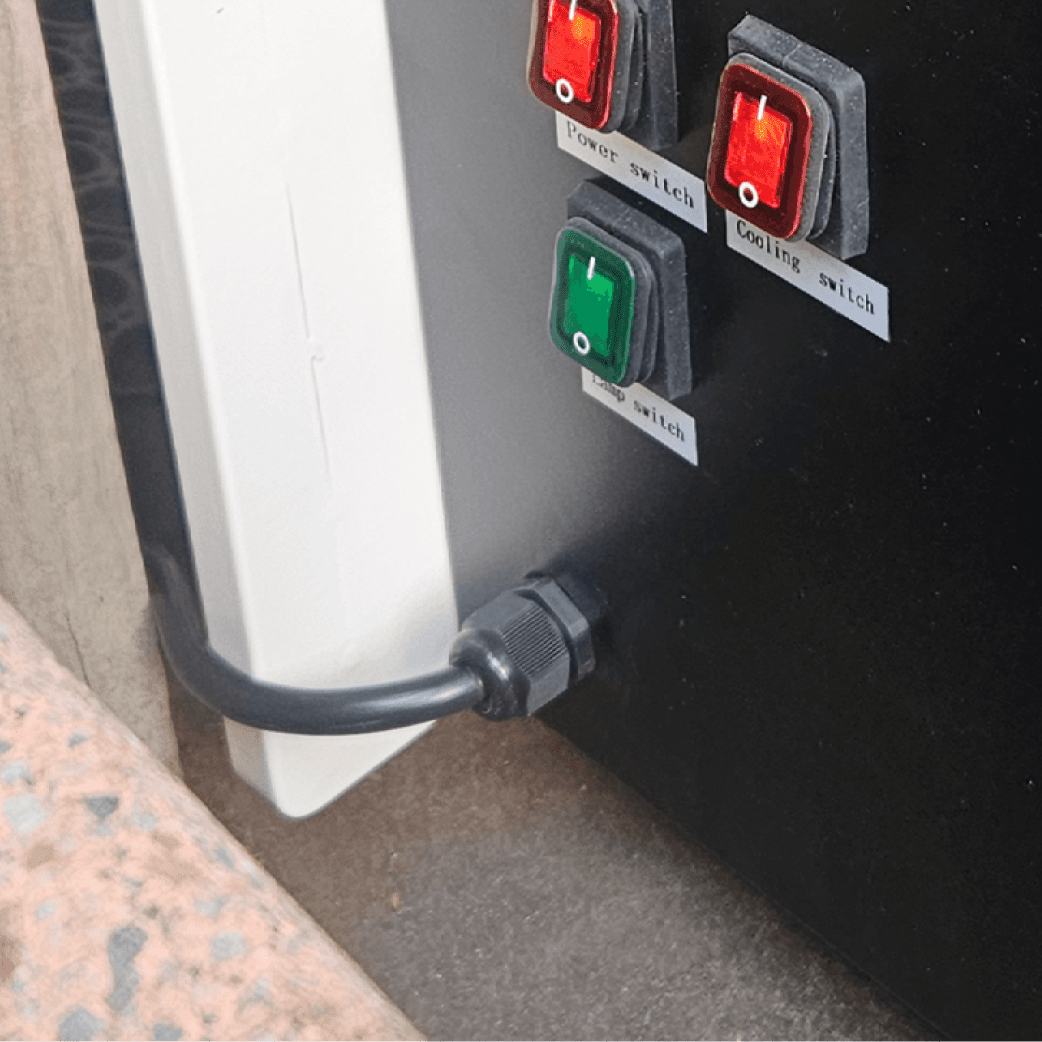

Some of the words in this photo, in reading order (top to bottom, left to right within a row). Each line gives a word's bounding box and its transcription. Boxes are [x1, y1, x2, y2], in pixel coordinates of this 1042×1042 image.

[566, 120, 618, 163] Power
[630, 162, 694, 209] switch
[736, 219, 801, 274] Cooling
[819, 272, 875, 315] switch
[633, 400, 685, 442] switch
